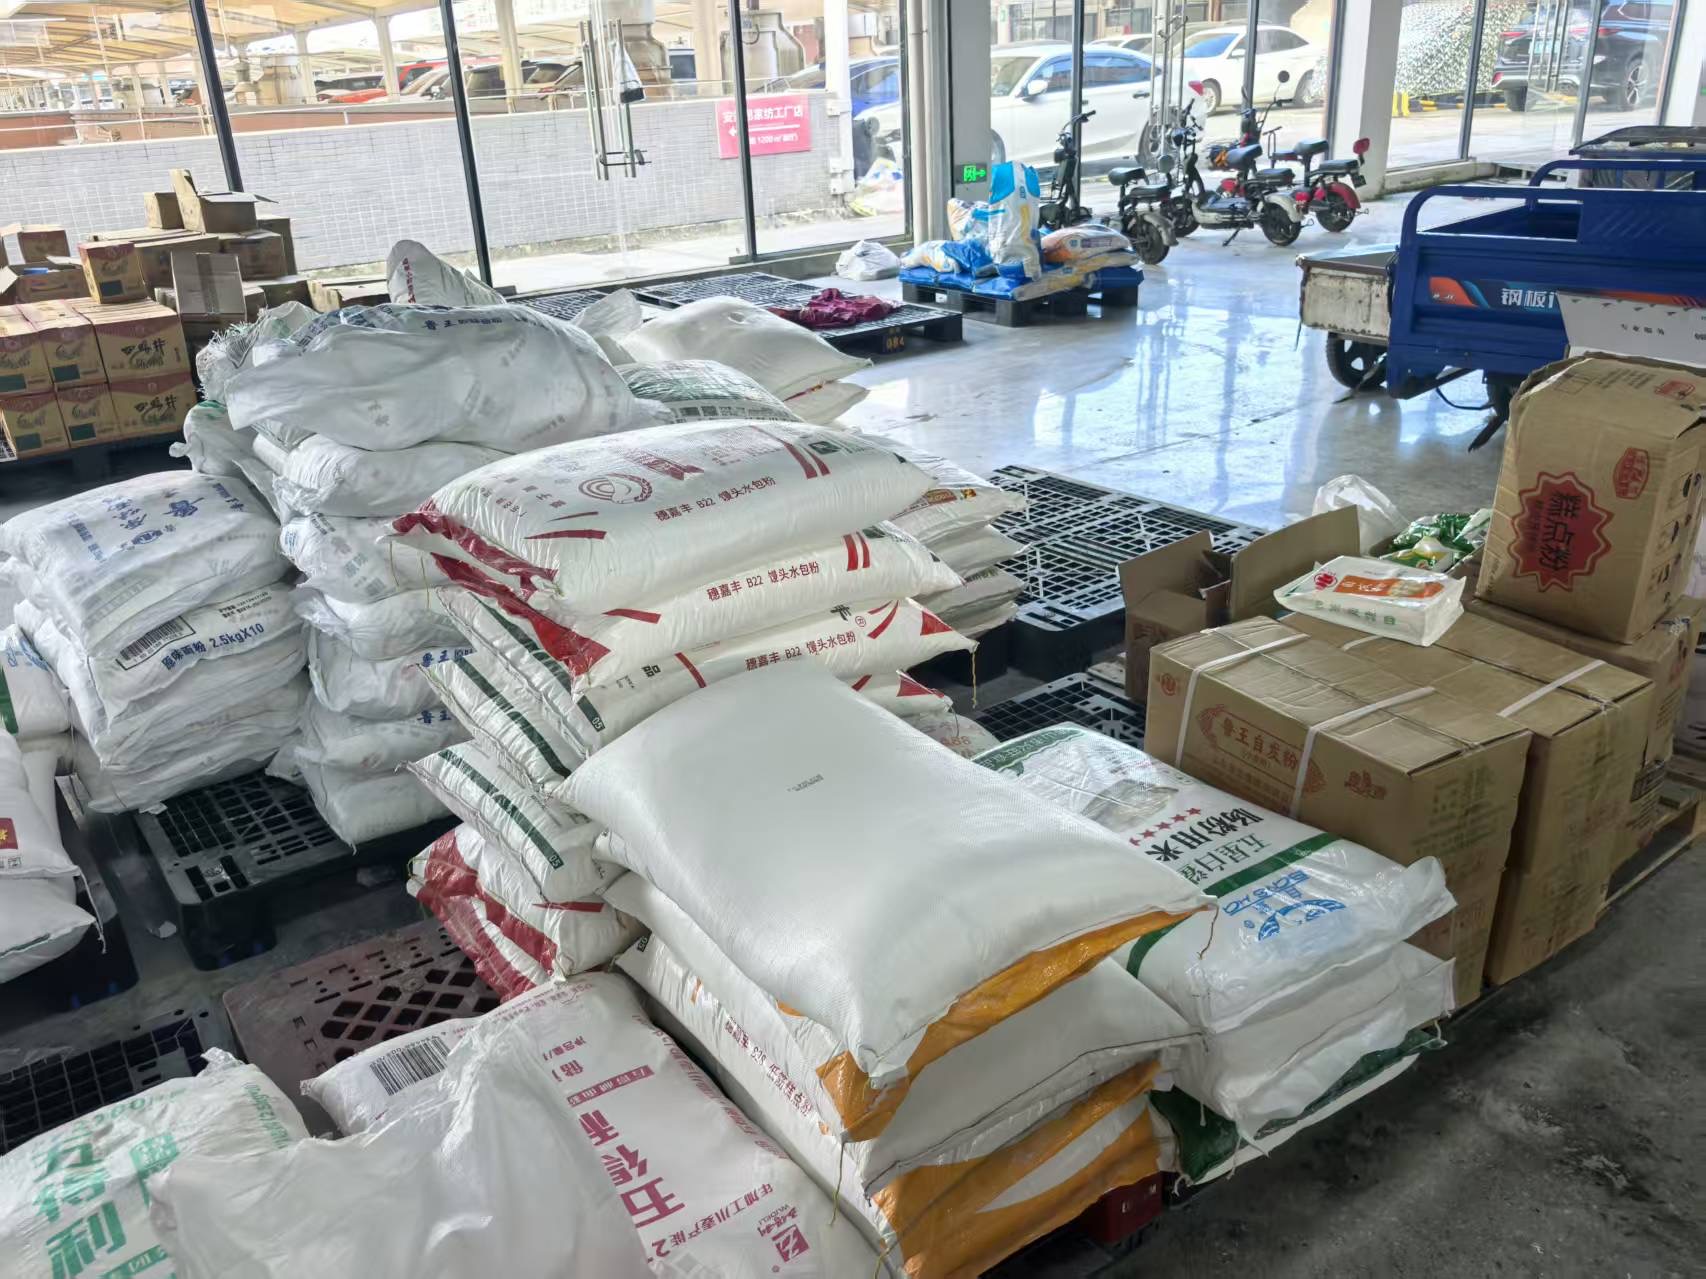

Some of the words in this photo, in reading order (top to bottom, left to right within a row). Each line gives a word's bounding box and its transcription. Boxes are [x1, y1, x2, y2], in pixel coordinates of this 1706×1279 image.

[696, 497, 716, 510] B22
[718, 475, 776, 503] 馒头水包粉
[707, 579, 743, 602] 穗嘉丰
[746, 574, 764, 589] B22
[767, 560, 820, 584] 馒头水包粉
[209, 622, 265, 649] 2.5kgX10
[745, 650, 781, 672] 穗嘉丰
[785, 645, 803, 660] B22
[805, 630, 857, 657] 馒头水包粉
[1223, 718, 1298, 770] 鲁王自发粉
[1145, 807, 1264, 862] 肠粉用米
[648, 1183, 774, 1264] 年加工小麦产能2
